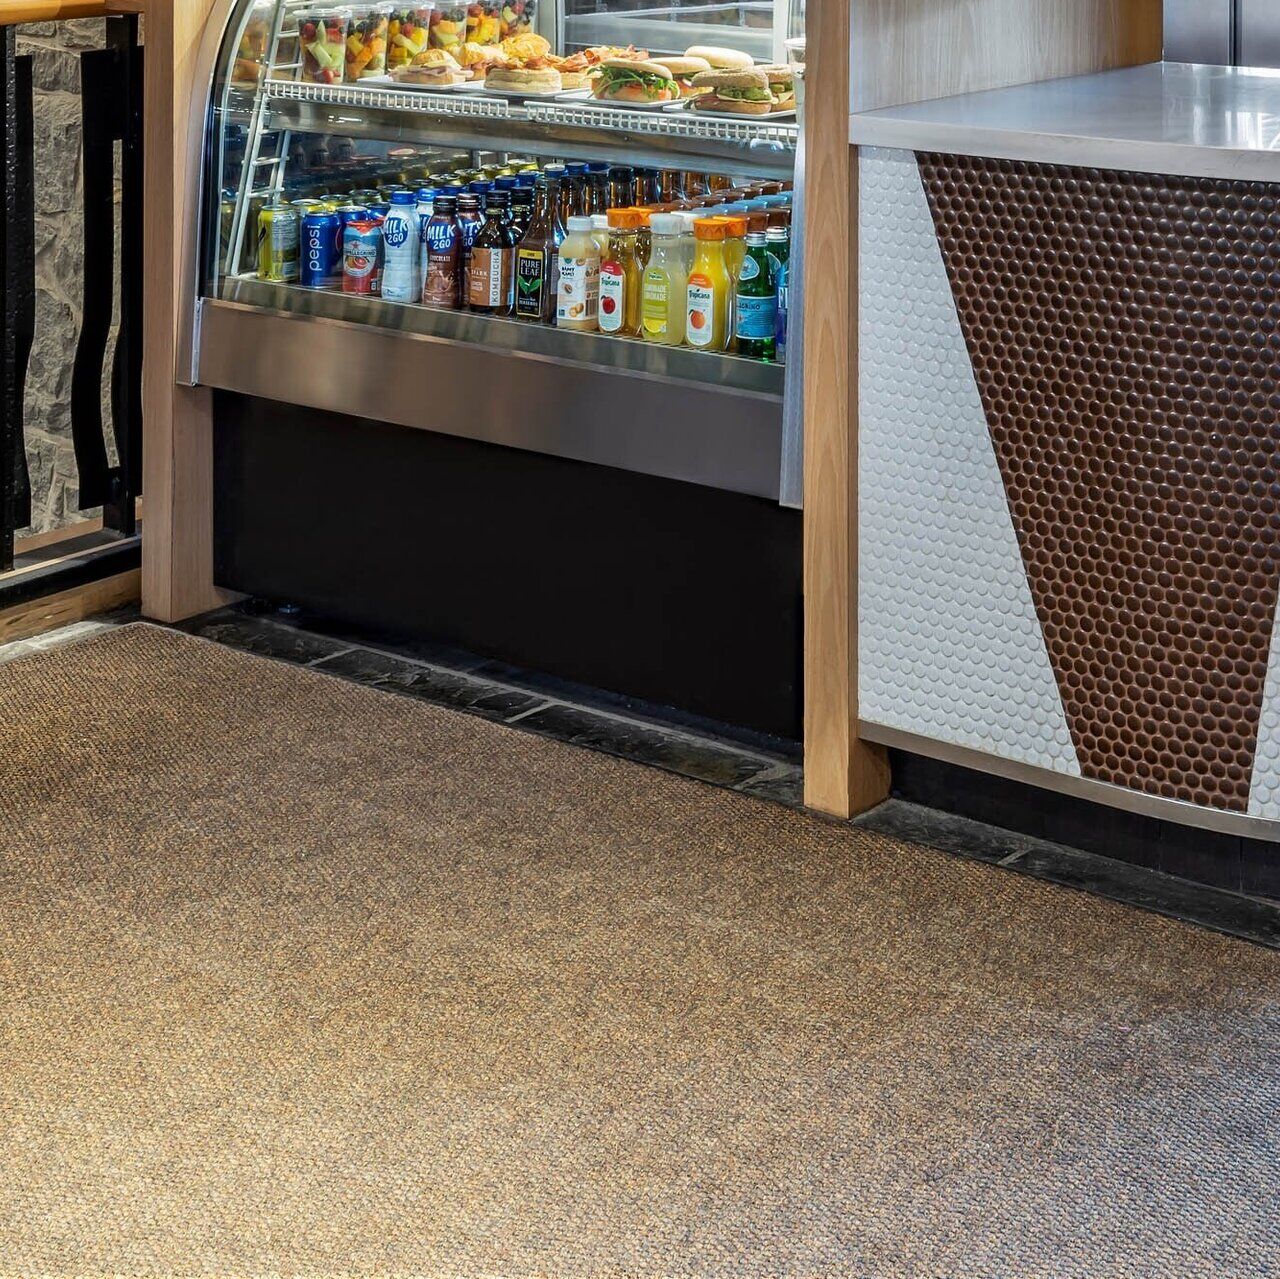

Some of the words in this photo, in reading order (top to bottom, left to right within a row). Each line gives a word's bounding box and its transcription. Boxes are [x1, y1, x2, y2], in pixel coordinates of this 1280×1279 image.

[427, 224, 456, 241] MILK
[388, 233, 404, 244] 2GO
[308, 225, 322, 270] pepsi
[433, 239, 451, 250] 2GO
[520, 259, 541, 268] PURE
[492, 251, 501, 303] KOMBUCHA
[520, 267, 540, 276] LEAF
[601, 276, 620, 286] Tropicana
[689, 288, 710, 300] Tropicana
